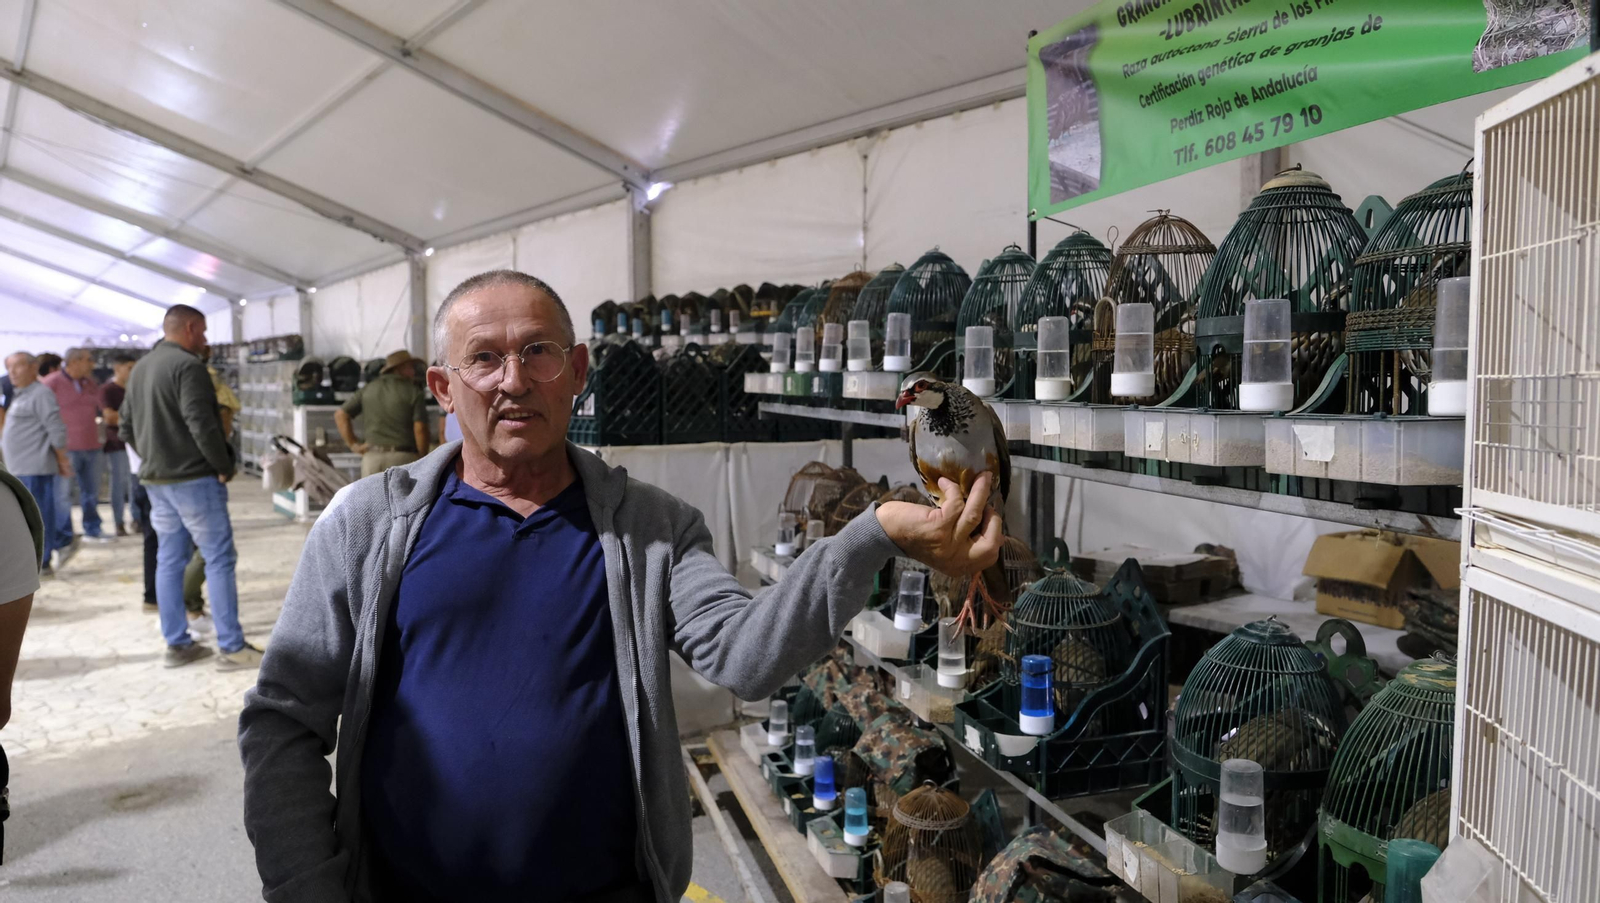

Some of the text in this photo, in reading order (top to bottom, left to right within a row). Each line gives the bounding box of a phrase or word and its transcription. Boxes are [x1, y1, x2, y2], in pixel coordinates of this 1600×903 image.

[1117, 0, 1172, 28] GRAN
[1122, 58, 1148, 79] Raza
[1150, 38, 1222, 66] autóctona
[1223, 22, 1268, 45] Sierra
[1273, 10, 1289, 30] de
[1289, 1, 1313, 20] los
[1138, 14, 1383, 109] Certificación genética de granjas de
[1205, 97, 1232, 120] Roja
[1235, 91, 1249, 109] de
[1251, 64, 1318, 103] Andalucía
[1173, 104, 1322, 166] Tlf. 608 45 79 10
